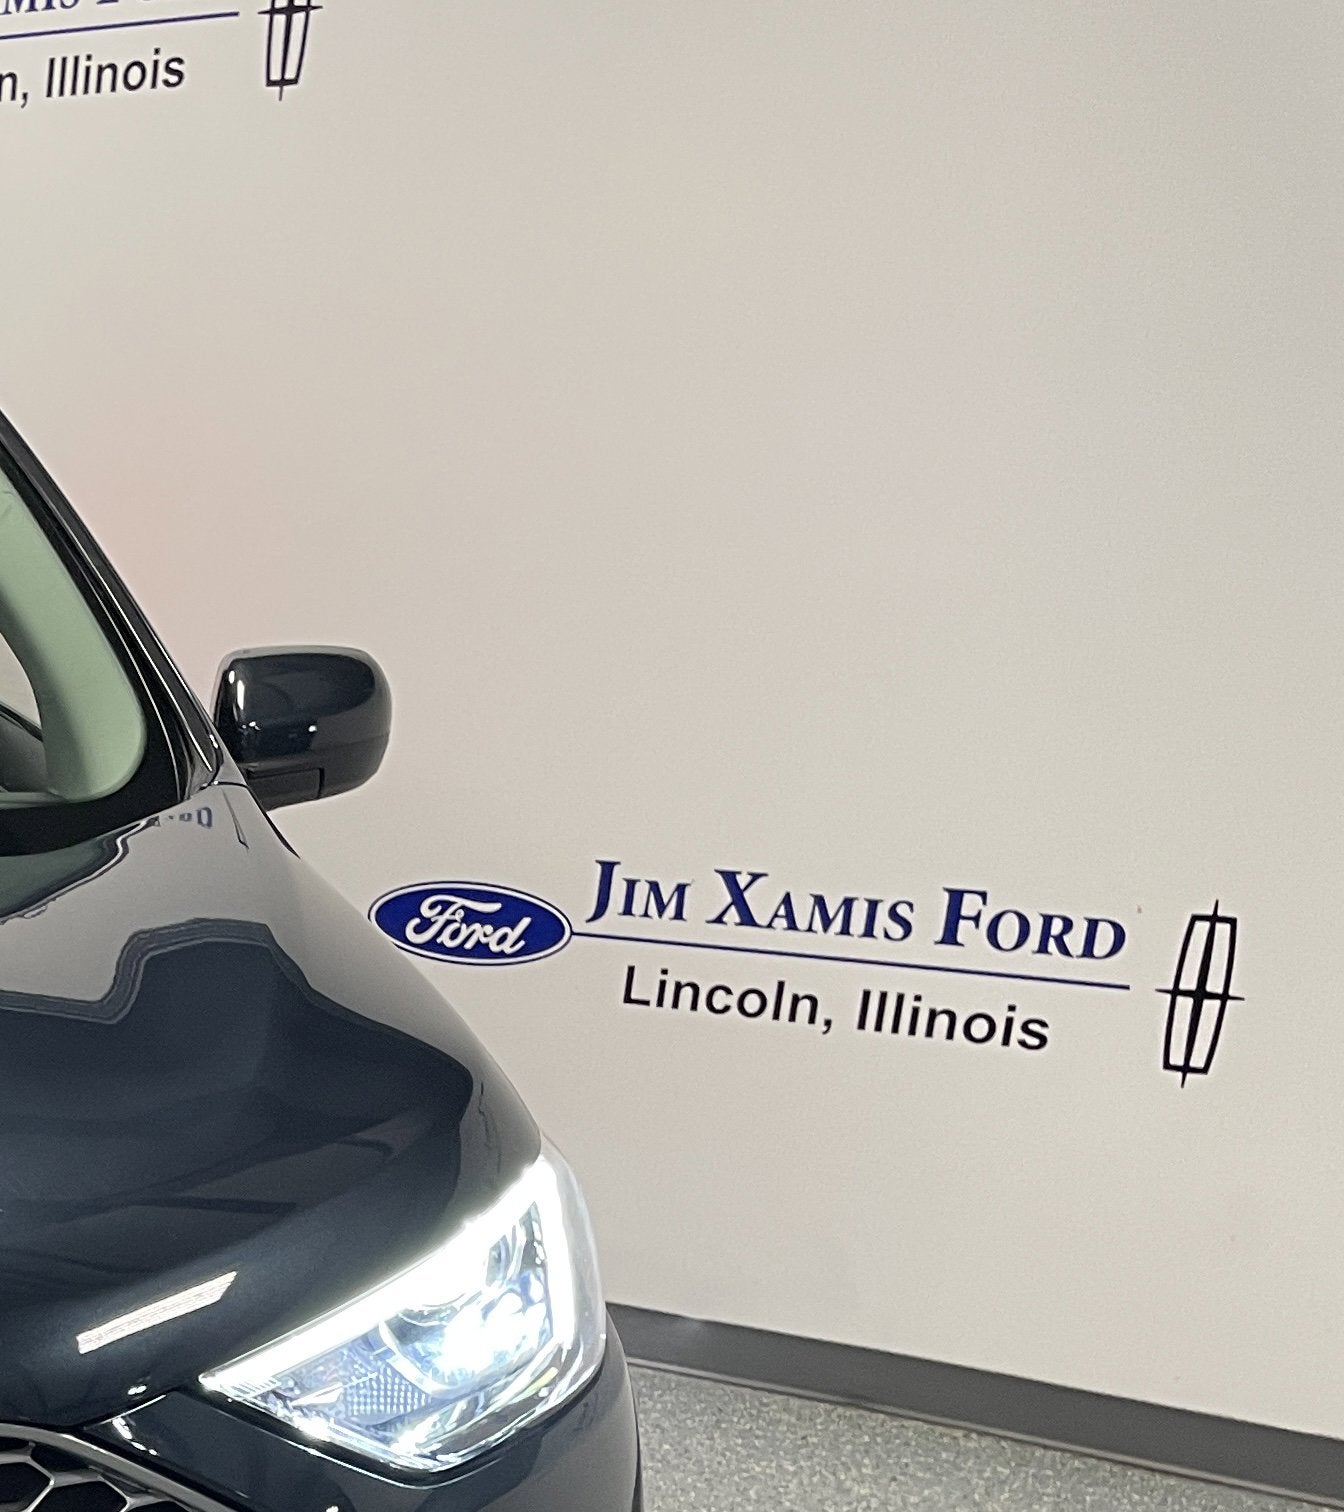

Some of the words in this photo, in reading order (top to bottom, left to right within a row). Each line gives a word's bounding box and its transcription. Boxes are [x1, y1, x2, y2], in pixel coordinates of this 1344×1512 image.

[45, 47, 185, 99] Illinois
[584, 858, 692, 924] JIM
[704, 868, 914, 943] XAMIS
[934, 886, 1127, 961] FORD
[621, 964, 834, 1036] Lincoln,
[856, 988, 1050, 1052] Illinois
